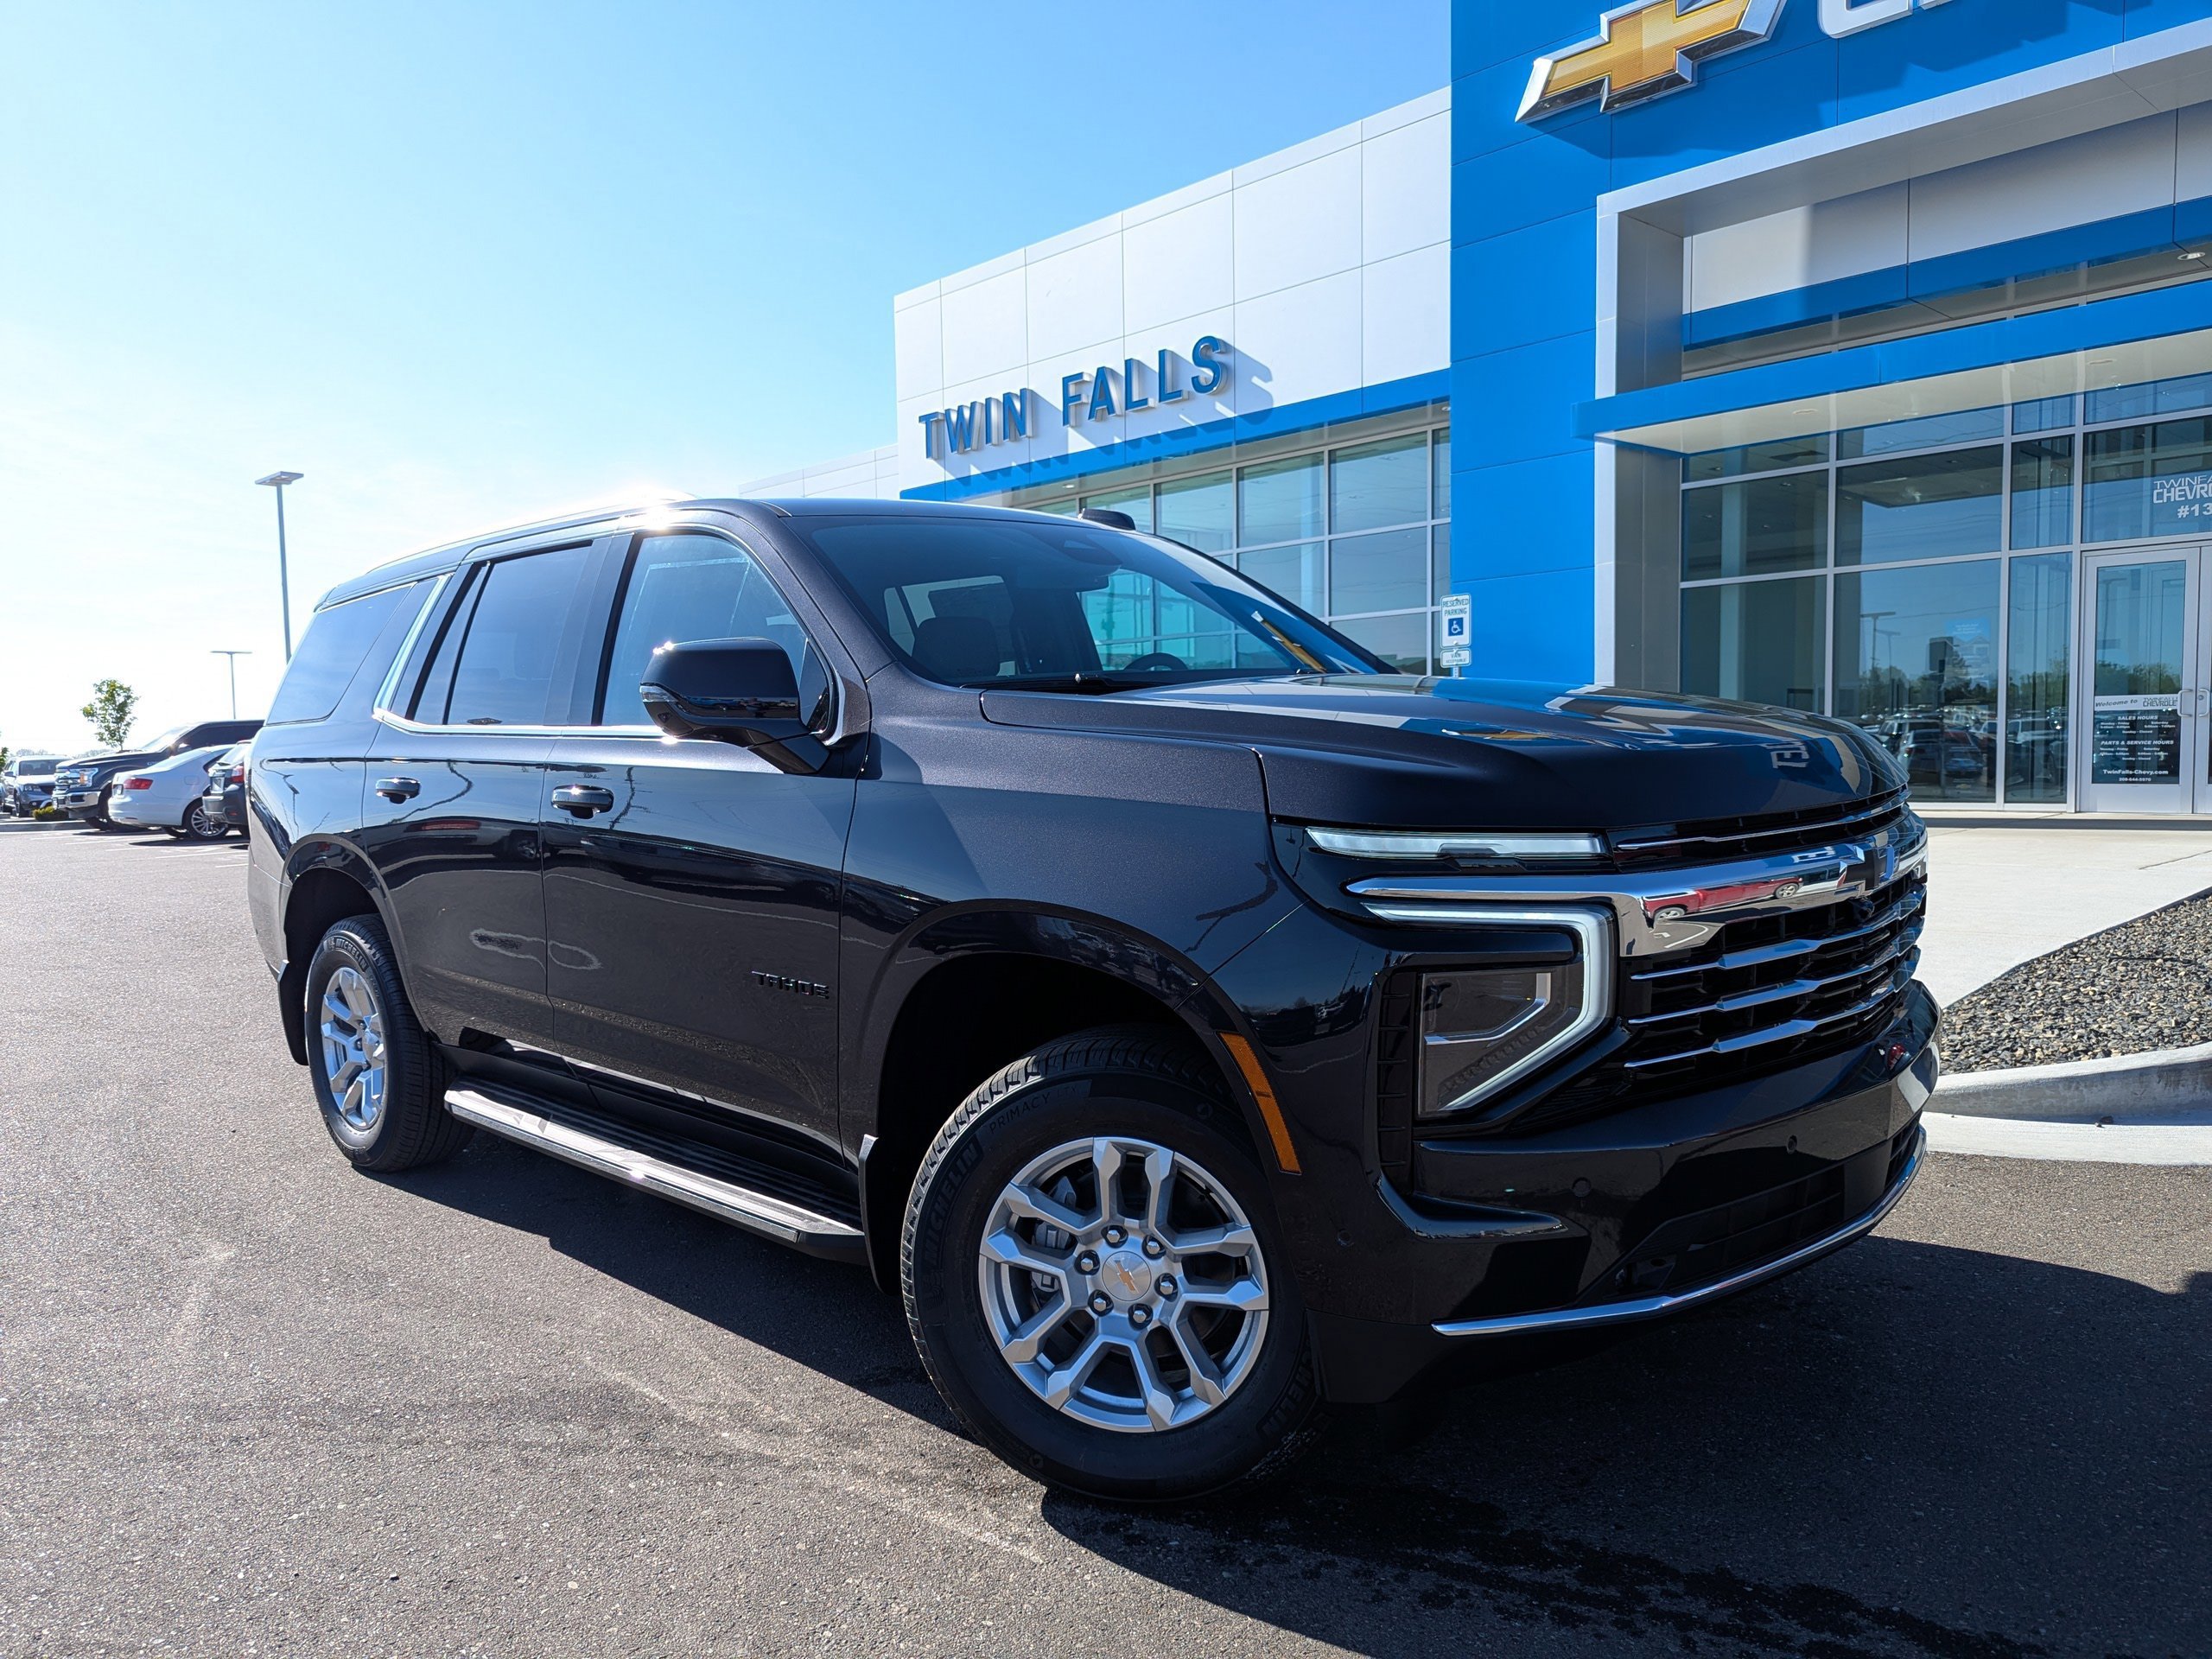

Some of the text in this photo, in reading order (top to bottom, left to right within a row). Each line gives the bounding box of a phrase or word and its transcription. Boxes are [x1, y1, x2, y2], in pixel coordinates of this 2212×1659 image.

[918, 335, 1230, 460] TWIN FALLS
[1442, 599, 1469, 607] RESERVED
[1444, 607, 1467, 617] PARKING
[335, 938, 367, 969] MICHELIN
[751, 970, 830, 999] TAHOE
[989, 1092, 1050, 1135] PRIMACY
[924, 1142, 980, 1264] MICHELIN
